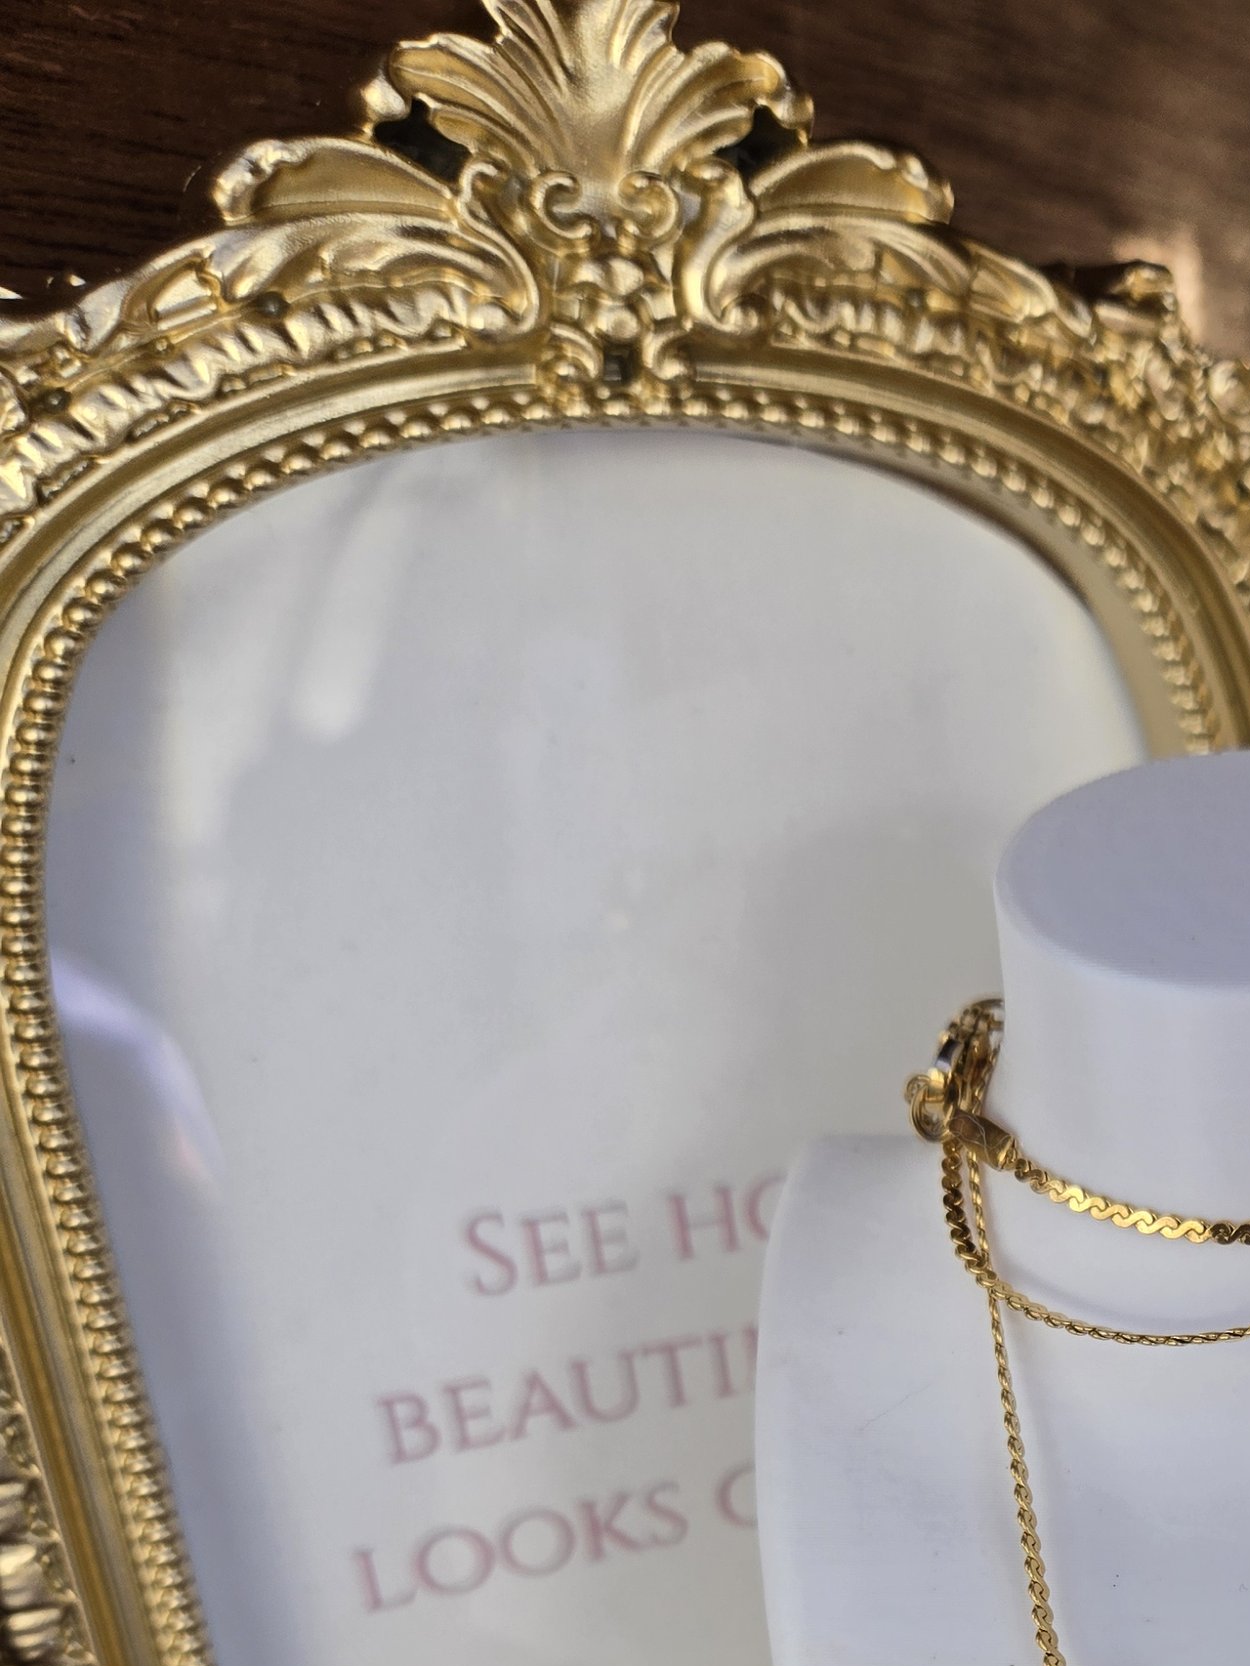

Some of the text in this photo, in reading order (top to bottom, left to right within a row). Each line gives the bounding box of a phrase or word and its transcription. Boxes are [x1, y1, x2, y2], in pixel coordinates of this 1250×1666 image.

[463, 1200, 640, 1298] SEE
[377, 1321, 757, 1465] BEAUTI
[352, 1481, 689, 1614] LOOKS
